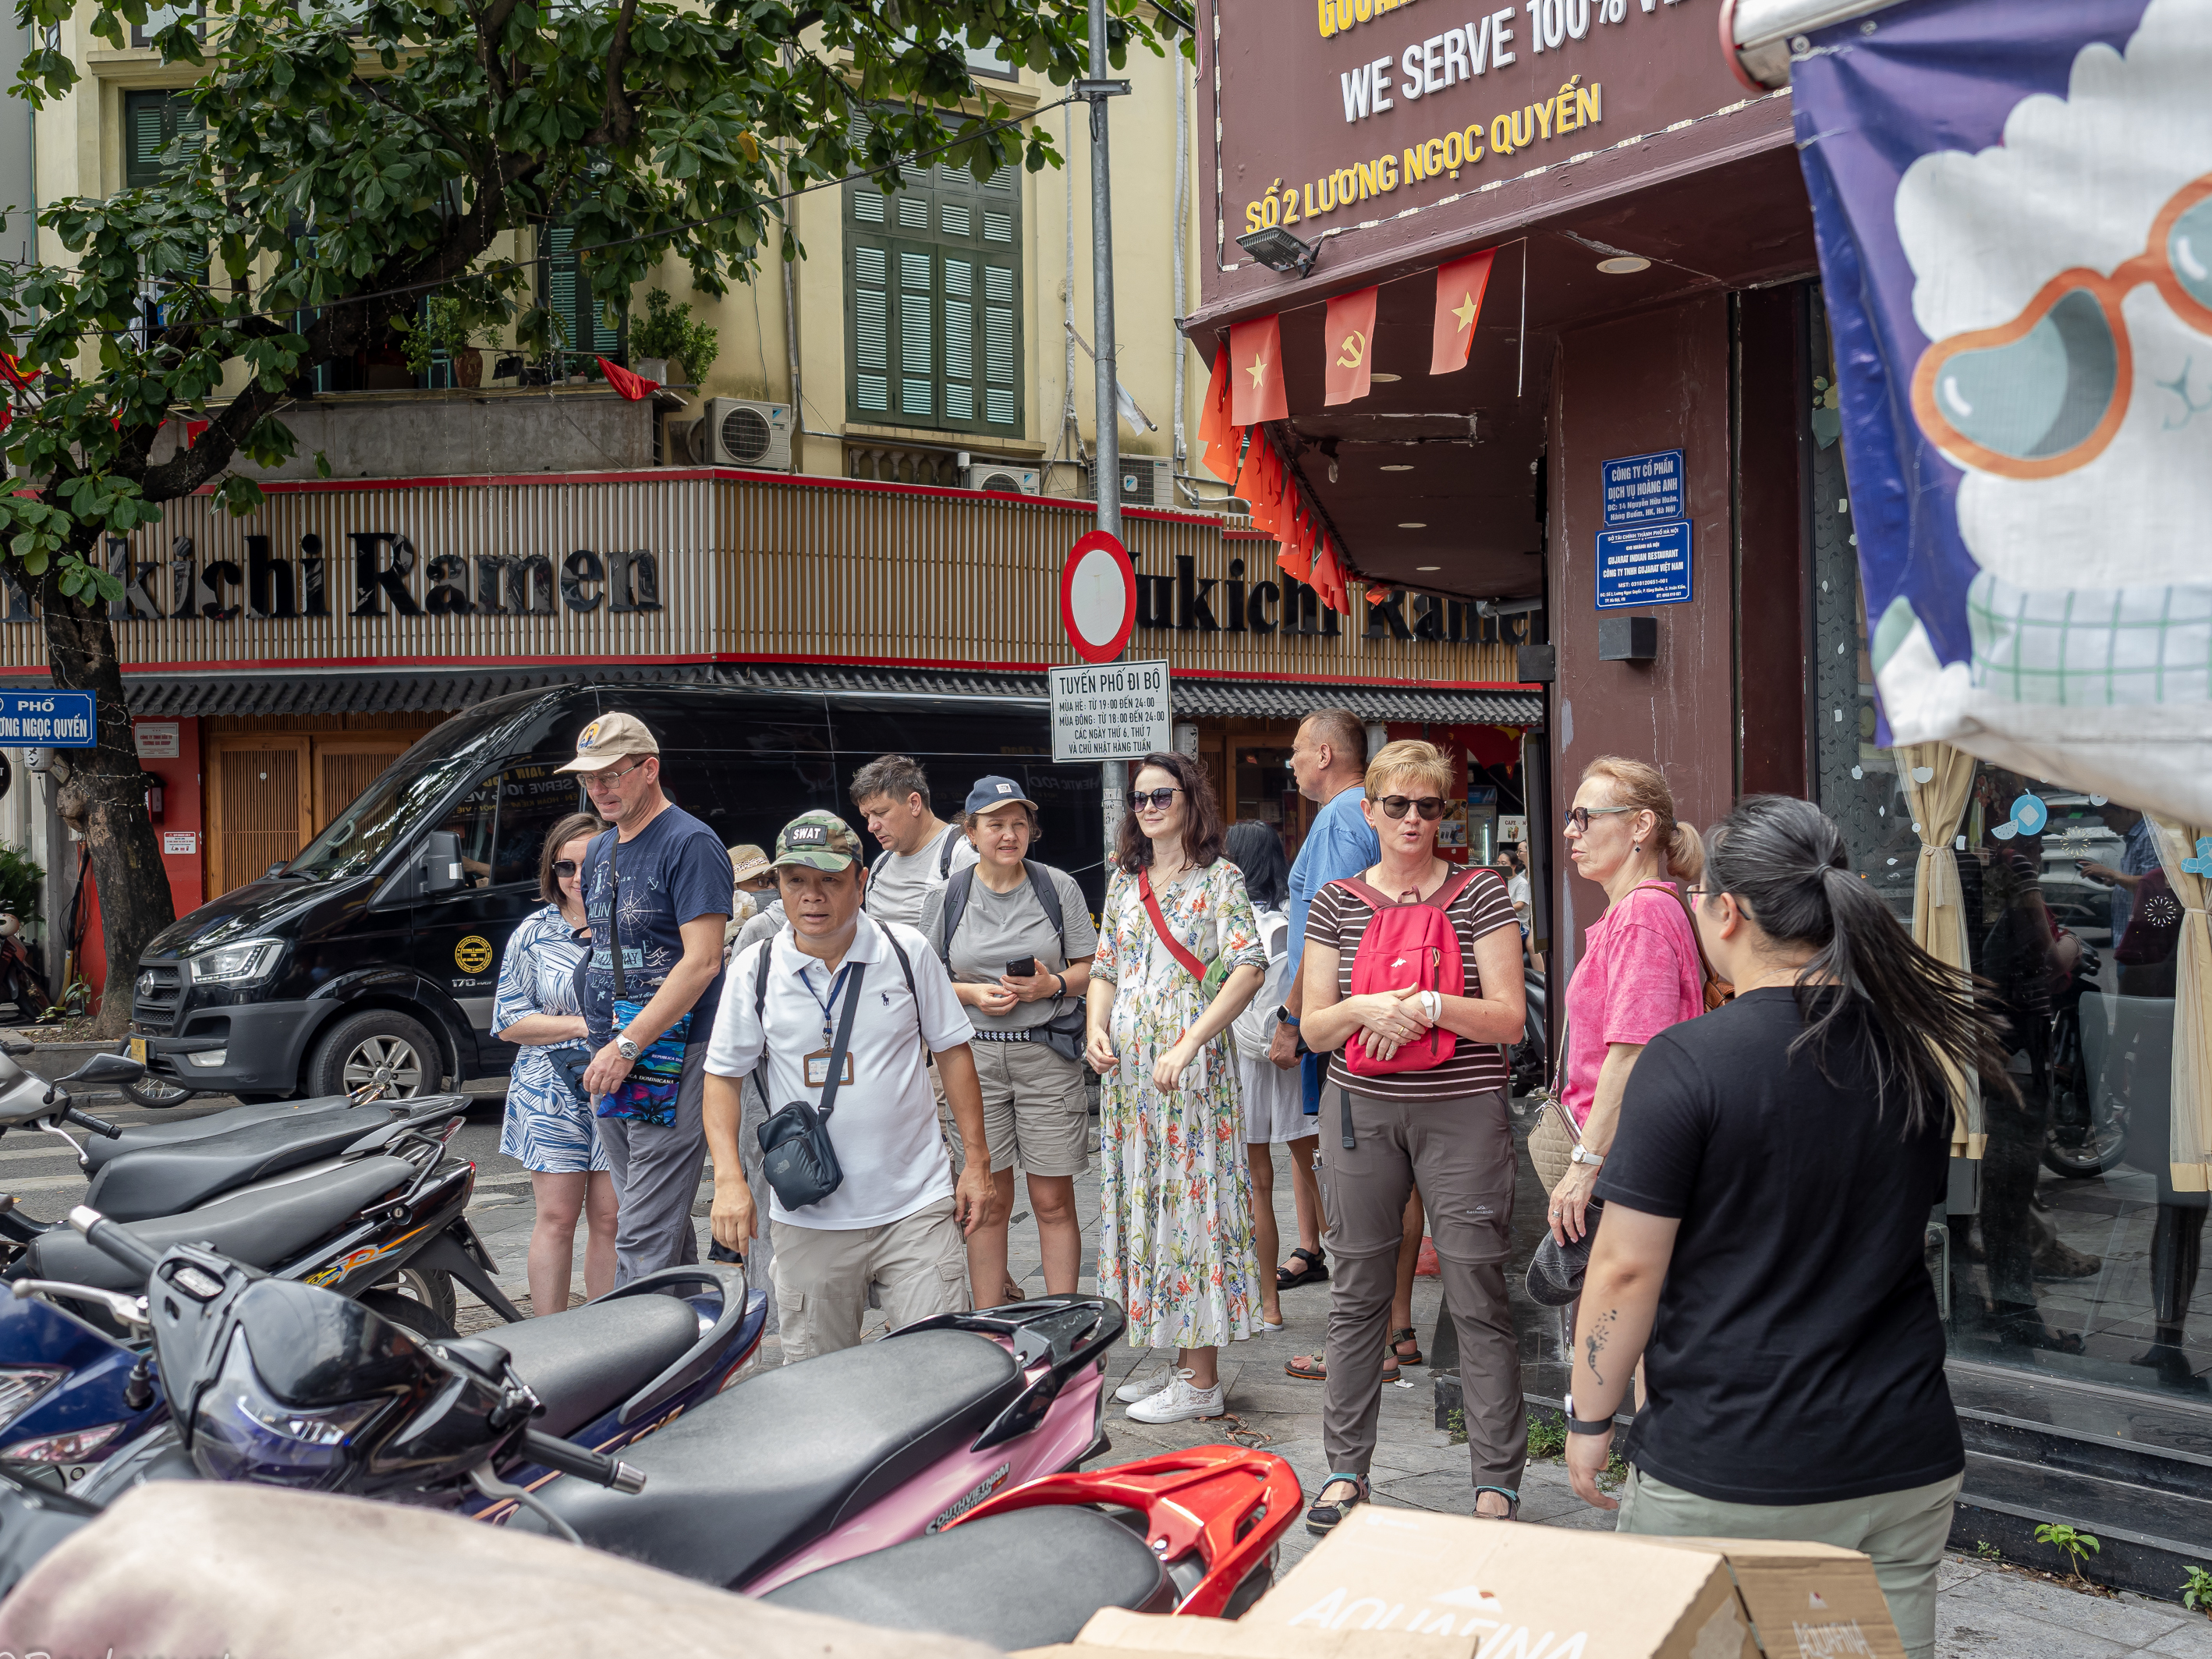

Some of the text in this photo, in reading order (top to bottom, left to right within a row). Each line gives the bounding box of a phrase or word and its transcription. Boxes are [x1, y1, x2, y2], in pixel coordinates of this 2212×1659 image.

[1340, 55, 1393, 124] WE
[1402, 6, 1515, 100] SERVE
[1246, 73, 1602, 234] SỐ 2 LƯƠNG NGỌC QUYẾN
[1611, 457, 1674, 482] CÔNG TY CỔ PHẦN
[1608, 477, 1678, 502] DỊCH VỤ HOÀNG ANH
[1627, 498, 1649, 509] Nguyễn
[1665, 505, 1675, 514] Nội
[1608, 548, 1678, 565] GUJARAT INDIAN RESTAURANT
[0, 531, 663, 622] kichi Ramen
[1603, 568, 1617, 578] CÔNG
[1637, 565, 1660, 575] GUJARAT
[1660, 562, 1671, 573] VIỆT
[1671, 561, 1684, 571] NAM
[1059, 667, 1161, 695] TUYẾN PHỐ ĐI BỘ
[17, 697, 55, 712] PHỐ
[1058, 694, 1155, 712] MÙA HÈ: TỪ 19:00 ĐẾN 24:00
[1058, 708, 1164, 726] MÙA ĐÔNG: TỪ 18:00 ĐẾN 24:00
[23, 718, 51, 741] NGỌC
[53, 713, 87, 739] QUYẾN
[1074, 725, 1087, 740] CÁC
[1089, 727, 1106, 739] NGÀY
[1108, 724, 1122, 739] THỨ
[1131, 724, 1144, 738] THỨ
[1146, 727, 1151, 737] 7
[1069, 737, 1151, 755] VÀ CHỦ NHẬT HÀNG TUẦN
[792, 828, 821, 841] SWAT
[452, 978, 476, 987] 170
[639, 1075, 675, 1085] DOMINICANA
